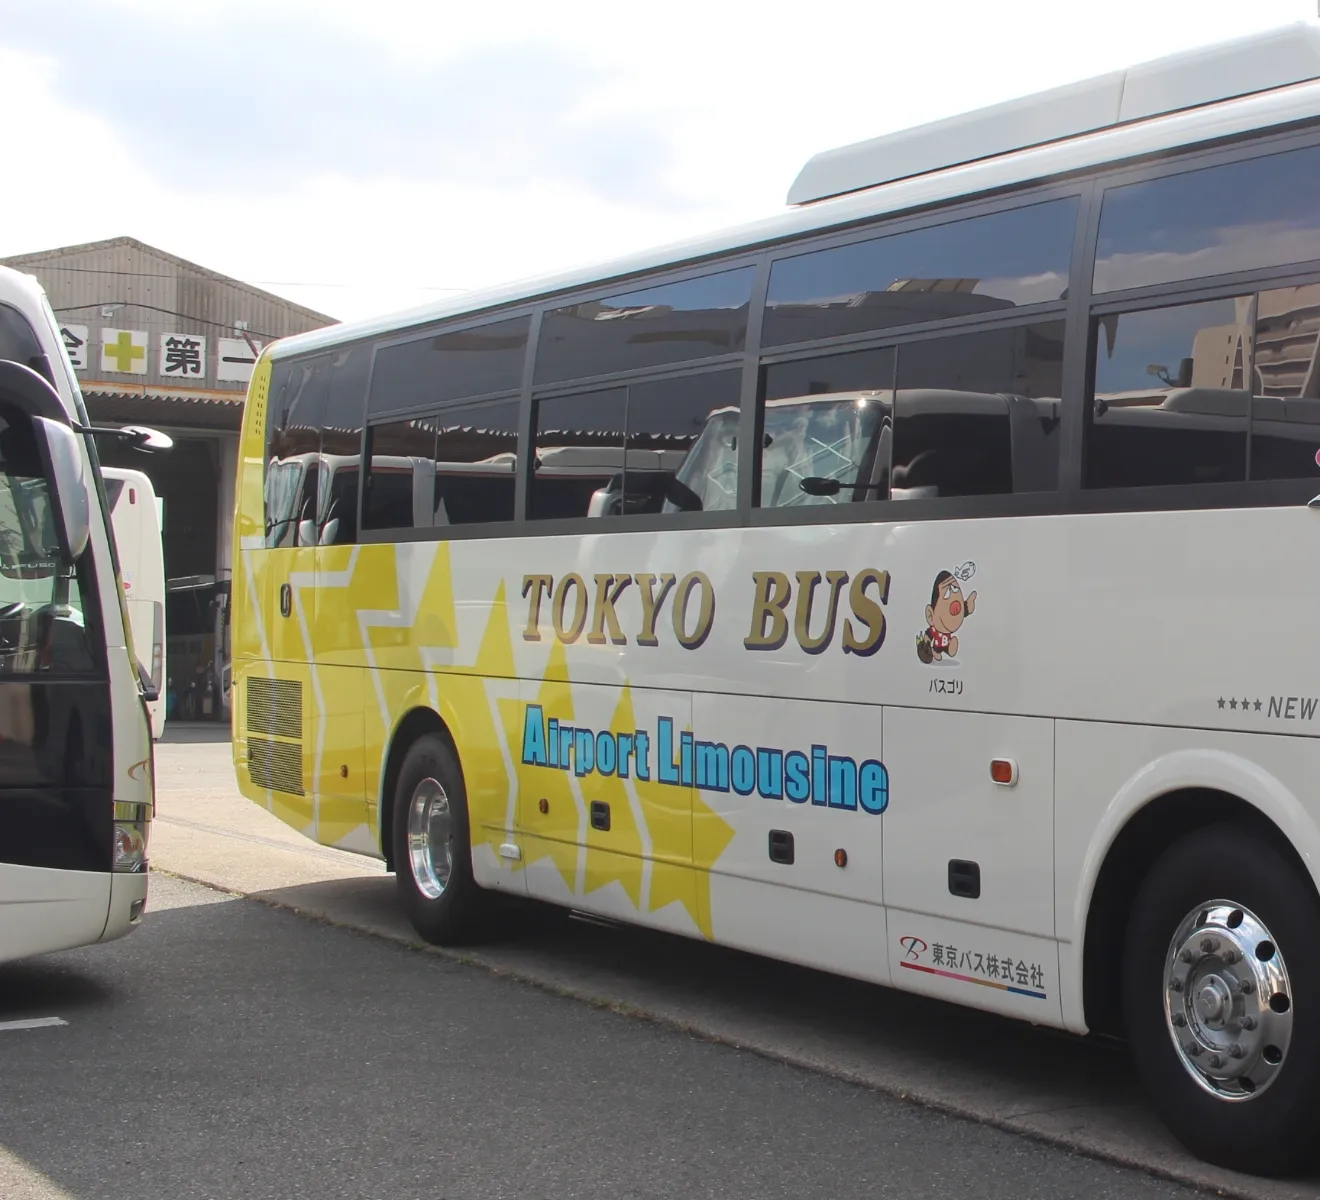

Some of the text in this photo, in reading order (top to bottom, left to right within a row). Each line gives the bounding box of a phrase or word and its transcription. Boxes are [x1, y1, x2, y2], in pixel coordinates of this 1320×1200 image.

[521, 568, 891, 657] TOKYO BUS
[929, 679, 963, 695] バスゴリ
[1267, 696, 1318, 720] NEW
[522, 703, 889, 815] Airport Limousine
[931, 942, 1045, 989] 東京バス株式会社
